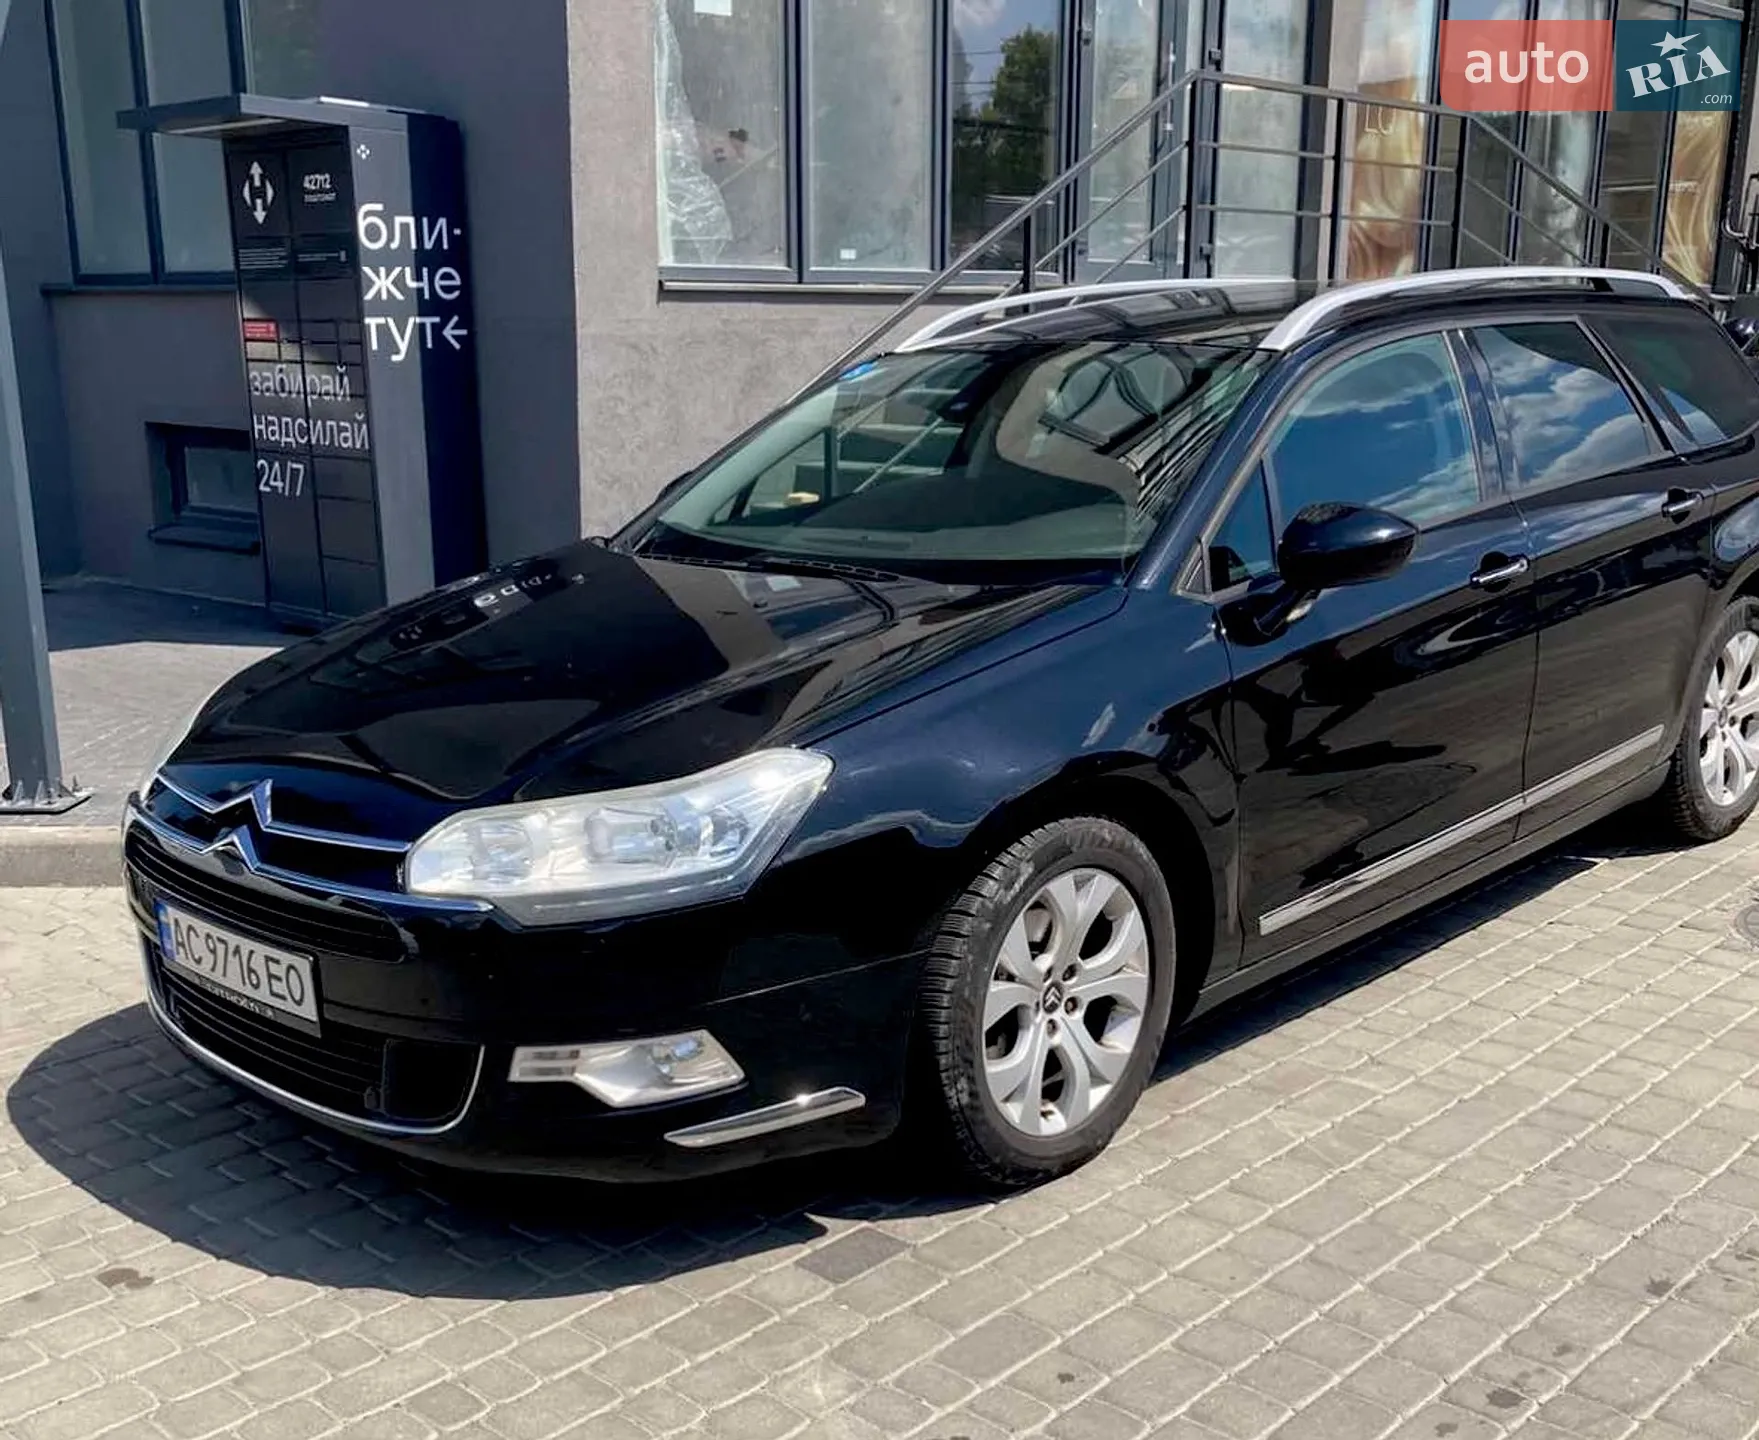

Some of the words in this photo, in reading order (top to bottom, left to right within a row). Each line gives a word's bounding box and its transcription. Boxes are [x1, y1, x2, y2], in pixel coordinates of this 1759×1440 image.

[361, 266, 462, 301] жче
[364, 316, 441, 362] тут
[250, 364, 351, 407] забирай
[253, 414, 369, 450] надсилай
[256, 459, 305, 497] 24/7
